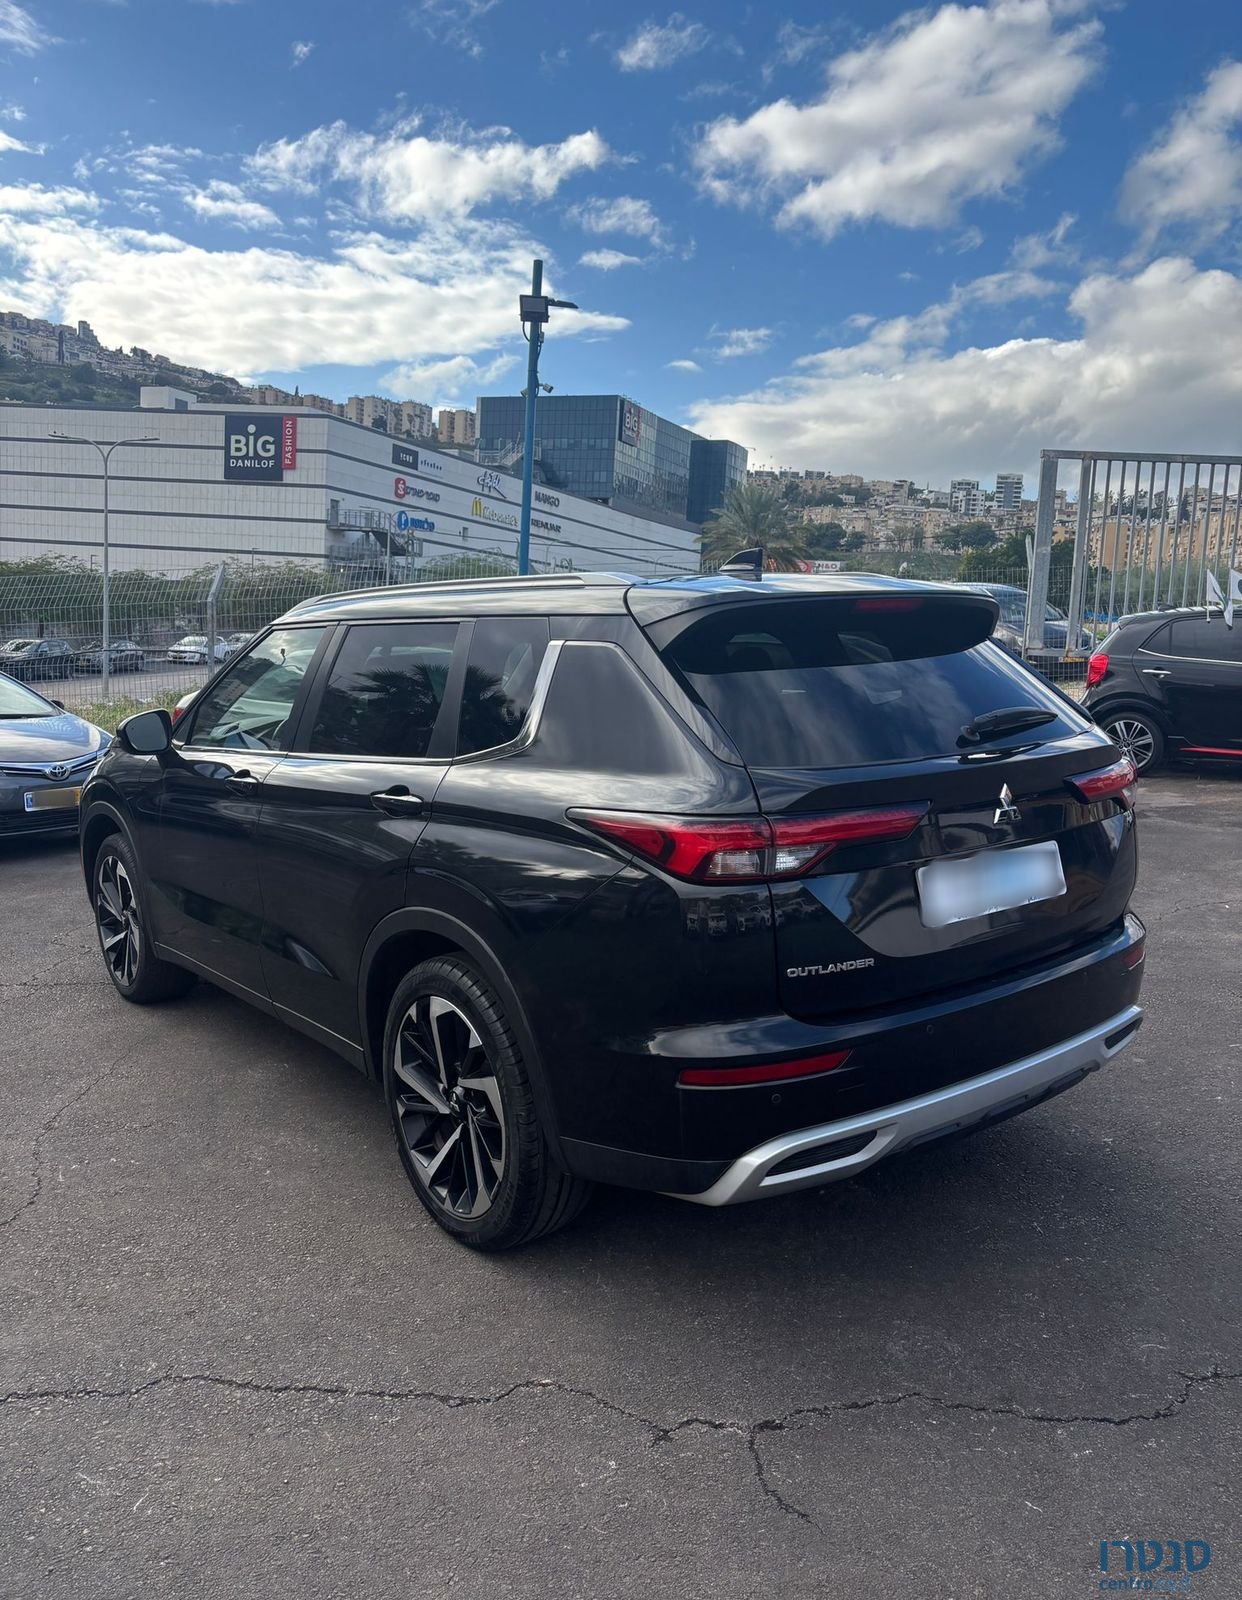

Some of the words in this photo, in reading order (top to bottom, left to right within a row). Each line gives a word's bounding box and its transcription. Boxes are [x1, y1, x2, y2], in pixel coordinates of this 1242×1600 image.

[285, 420, 293, 464] FASHION
[230, 459, 275, 468] DANILOF
[786, 958, 875, 977] OUTLANDER
